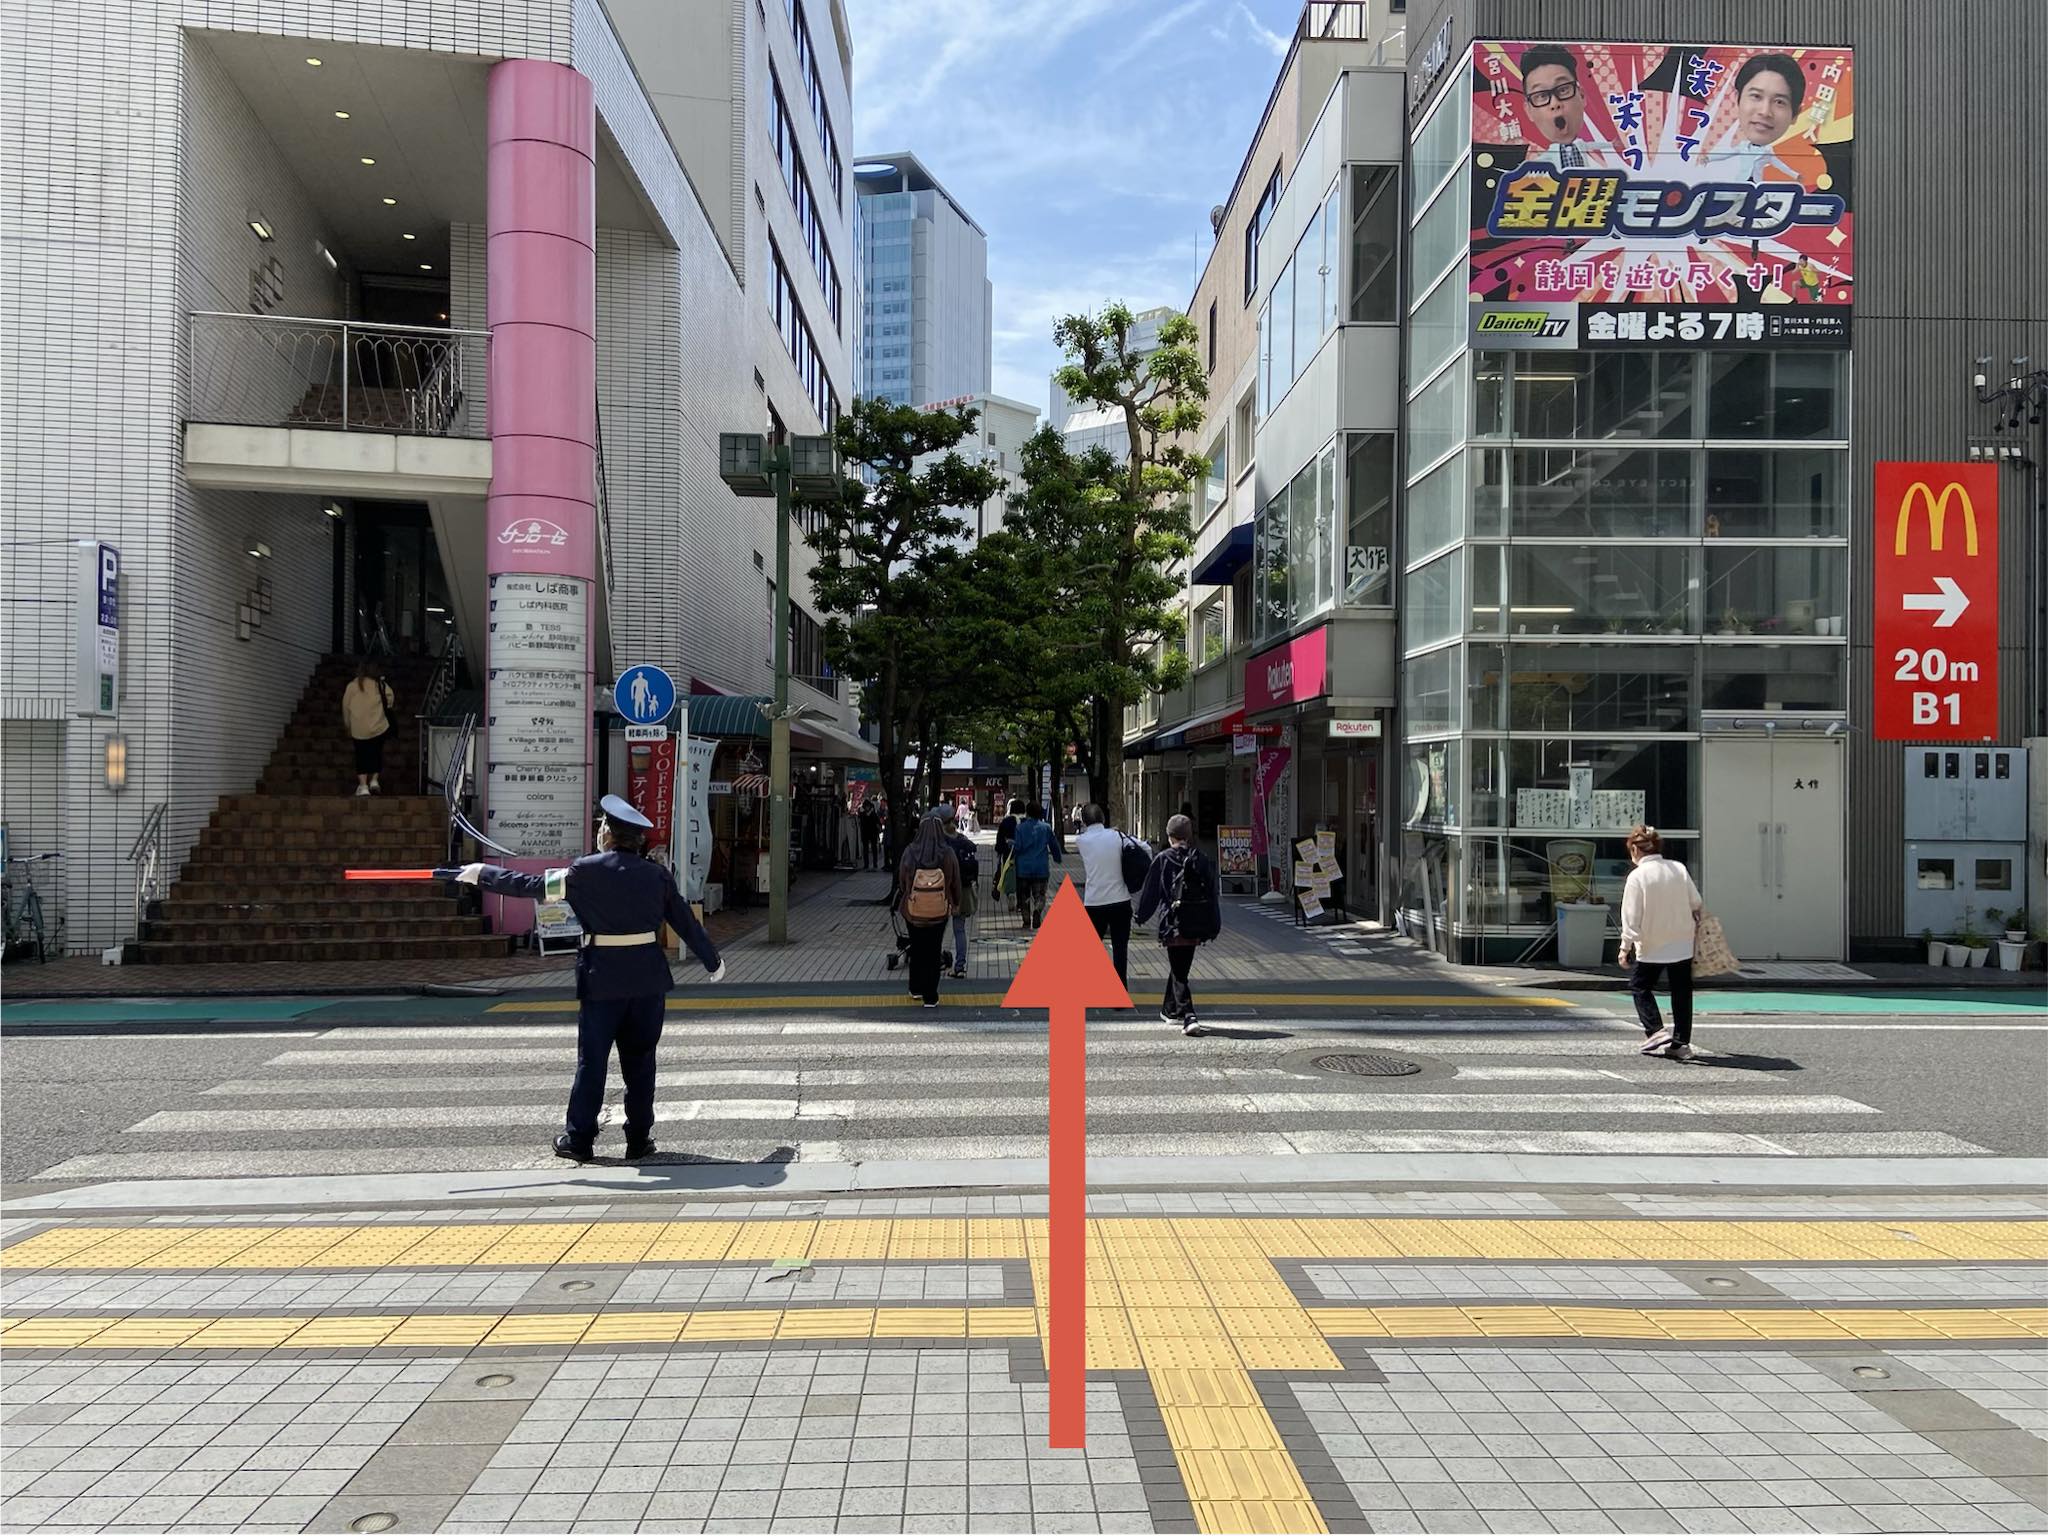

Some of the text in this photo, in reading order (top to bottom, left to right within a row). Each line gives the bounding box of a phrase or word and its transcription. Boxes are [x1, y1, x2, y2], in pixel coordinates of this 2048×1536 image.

[1483, 54, 1522, 140] 宮川大輔
[1675, 55, 1723, 162] 笑って
[1609, 93, 1644, 171] 笑う
[1495, 169, 1838, 231] 金曜モンスター
[1482, 315, 1566, 336] Daiichi TV
[1588, 311, 1764, 340] 金曜よる7時
[497, 527, 568, 545] サンローゼ
[102, 549, 117, 591] P
[535, 581, 579, 596] しば商事
[519, 601, 568, 611] しば内科医院
[1266, 660, 1294, 691] Rakuten
[1894, 649, 1979, 682] 20m
[1912, 692, 1961, 725] B1
[628, 728, 665, 738] 軽車両を除く
[1336, 722, 1374, 732] Rakuten
[526, 792, 554, 800] colors
[655, 742, 671, 830] COFFEE
[985, 776, 1002, 787] KFC
[499, 821, 529, 829] docomo
